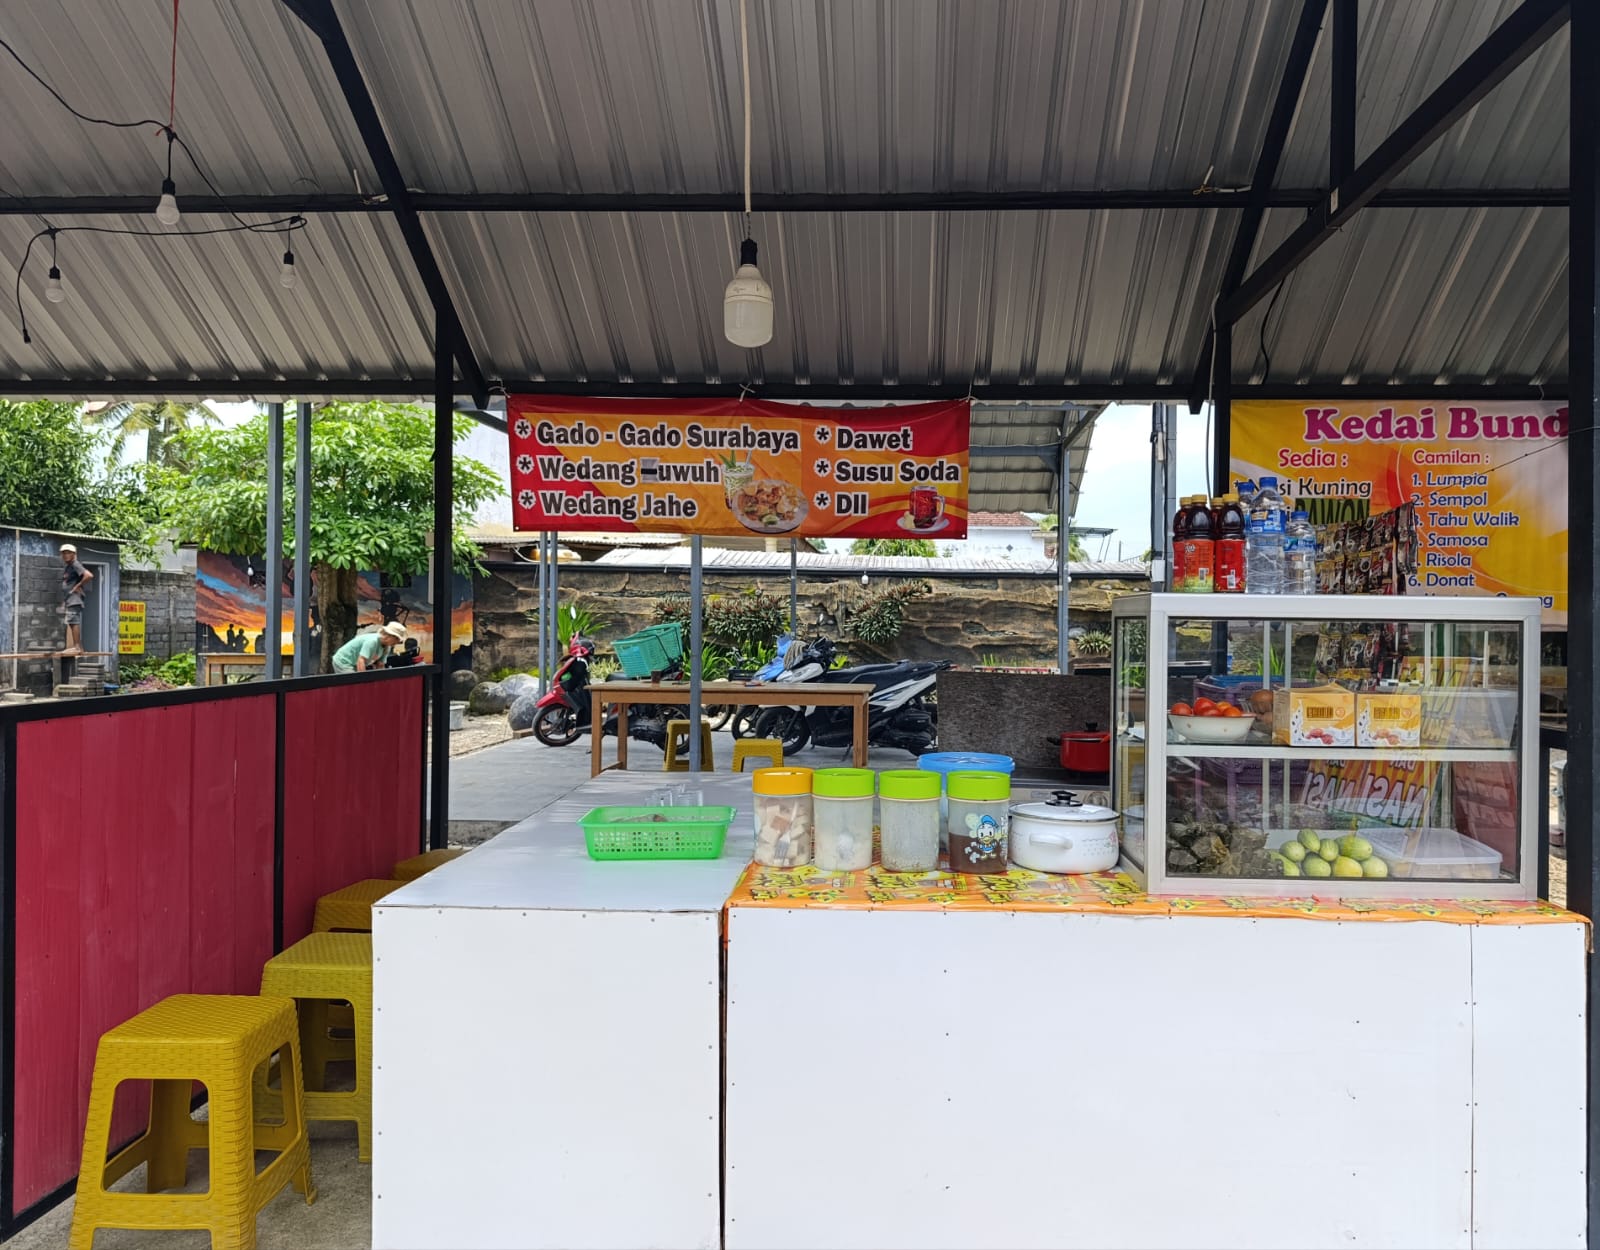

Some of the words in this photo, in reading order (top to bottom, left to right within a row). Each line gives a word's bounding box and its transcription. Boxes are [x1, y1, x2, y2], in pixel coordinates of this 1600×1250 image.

[1303, 408, 1435, 439] Kedai
[537, 421, 600, 445] Gado
[619, 423, 682, 446] Gado
[687, 424, 799, 454] Surabaya
[837, 428, 911, 449] Dawet
[1279, 448, 1336, 467] Sedia
[1413, 450, 1480, 463] Camilan
[538, 457, 636, 486] Wedang
[835, 461, 894, 482] Susu
[900, 460, 960, 482] Soda
[1427, 472, 1487, 488] Lumpia
[1298, 478, 1372, 498] Kuning
[540, 491, 637, 520] Wedang
[642, 494, 697, 517] Jahe
[836, 494, 867, 514] Dll
[1430, 492, 1487, 508] Sempol
[1428, 512, 1468, 526] Tahu
[1473, 512, 1520, 526] Walik
[1428, 533, 1489, 547] Samosa
[1426, 553, 1472, 567] Risola
[1408, 575, 1421, 587] 6.
[1426, 573, 1475, 587] Donat
